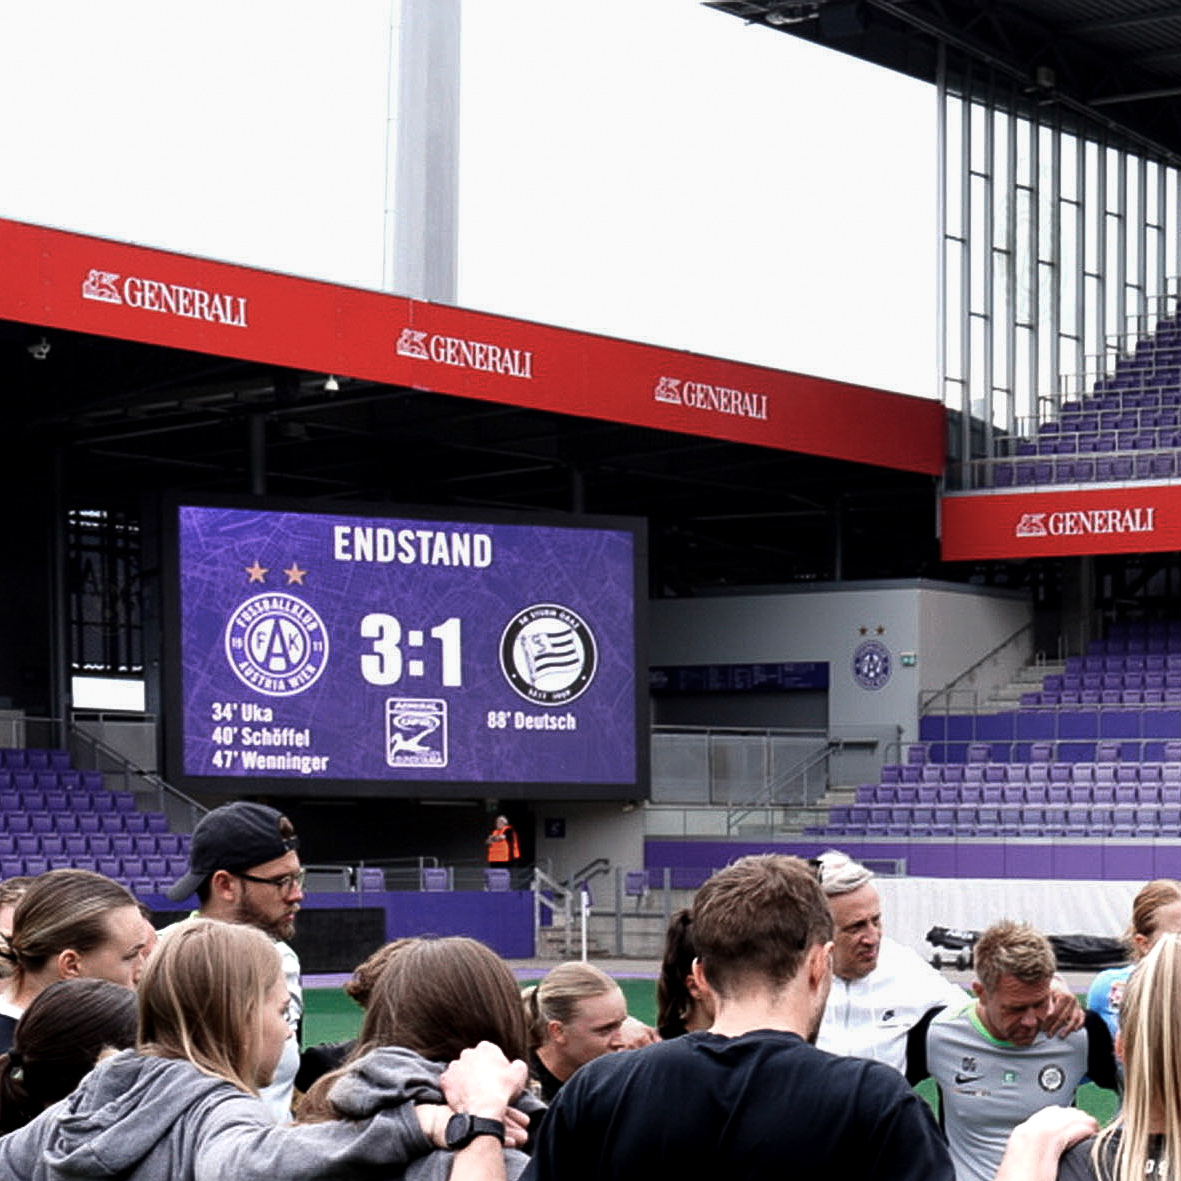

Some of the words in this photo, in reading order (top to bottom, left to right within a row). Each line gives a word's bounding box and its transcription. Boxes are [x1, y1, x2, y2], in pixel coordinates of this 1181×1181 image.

[123, 276, 248, 328] GENERALI
[430, 334, 532, 379] GENERALI
[682, 381, 767, 420] GENERALI
[1048, 507, 1154, 536] GENERALI
[334, 525, 492, 568] ENDSTAND
[360, 612, 463, 687] 3:1
[241, 703, 273, 722] Uka
[514, 711, 577, 730] Deutsch
[241, 726, 310, 748] Schöffel
[241, 750, 329, 774] Wenninger
